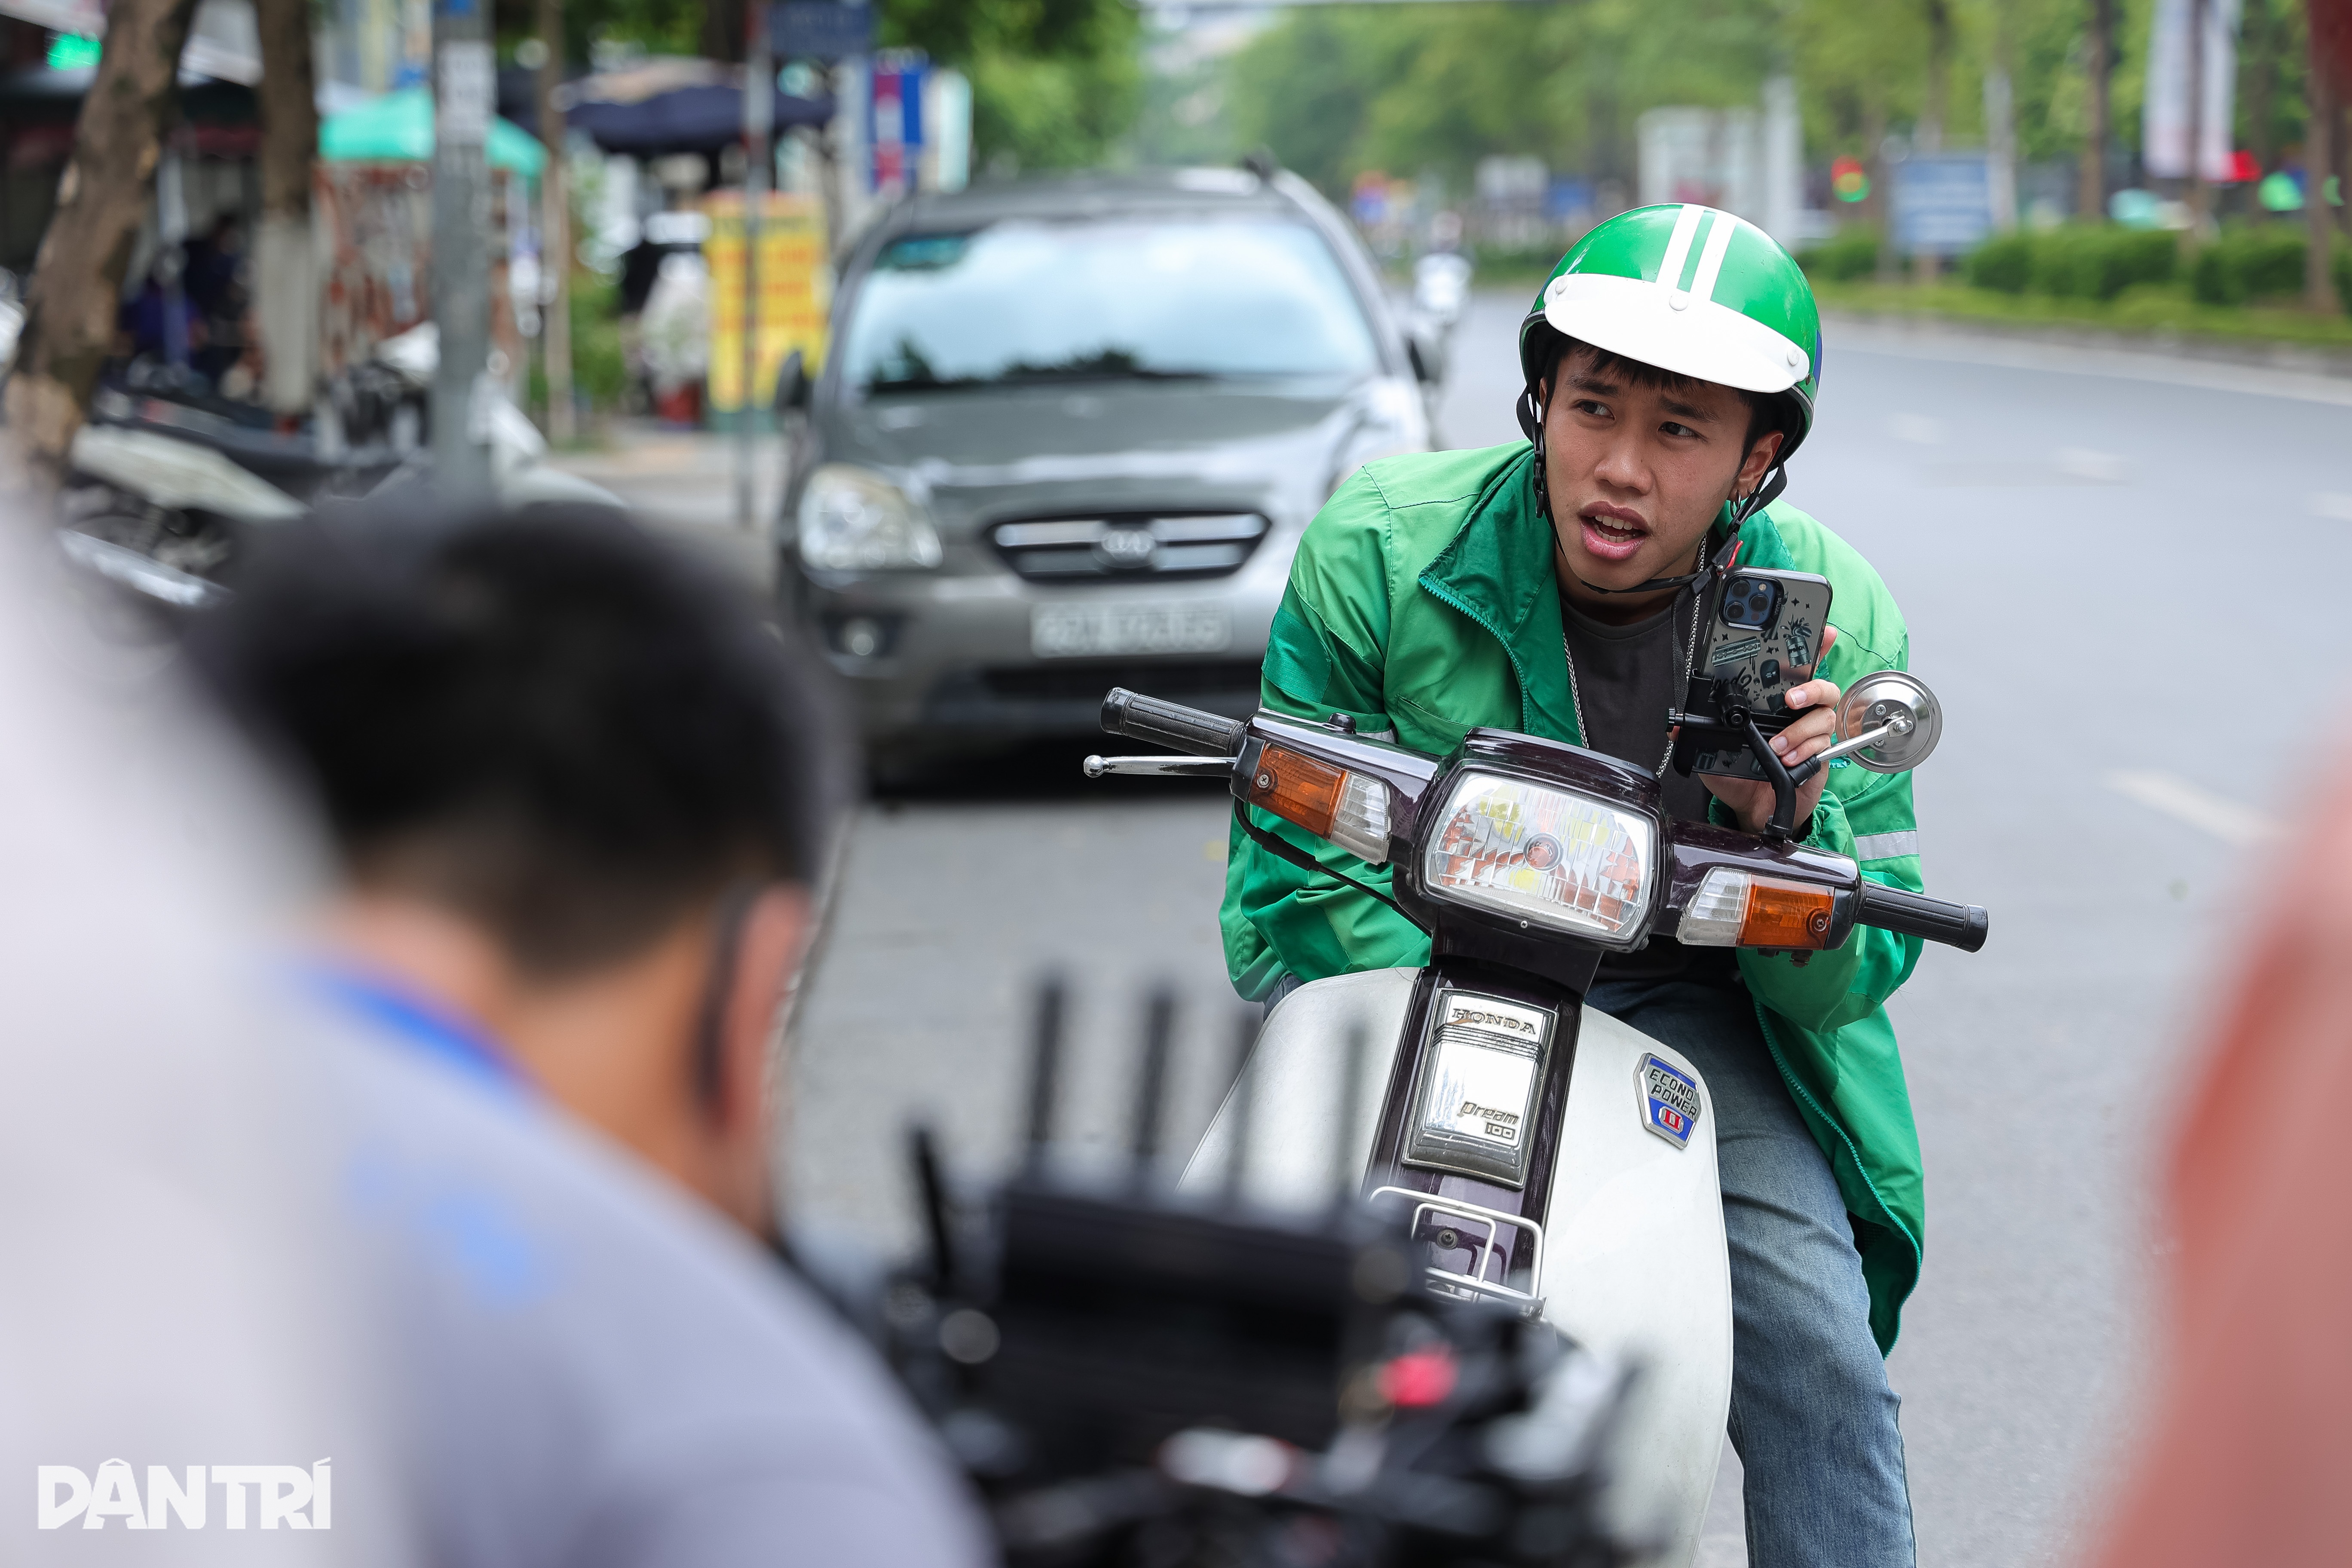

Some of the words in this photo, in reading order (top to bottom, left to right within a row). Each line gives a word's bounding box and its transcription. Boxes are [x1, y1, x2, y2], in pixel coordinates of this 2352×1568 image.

[1452, 1008, 1536, 1035] HONDA
[1649, 1069, 1694, 1101] ECONO
[1457, 1101, 1519, 1125] Dream
[1651, 1084, 1697, 1118] POWER
[1485, 1122, 1516, 1140] 100
